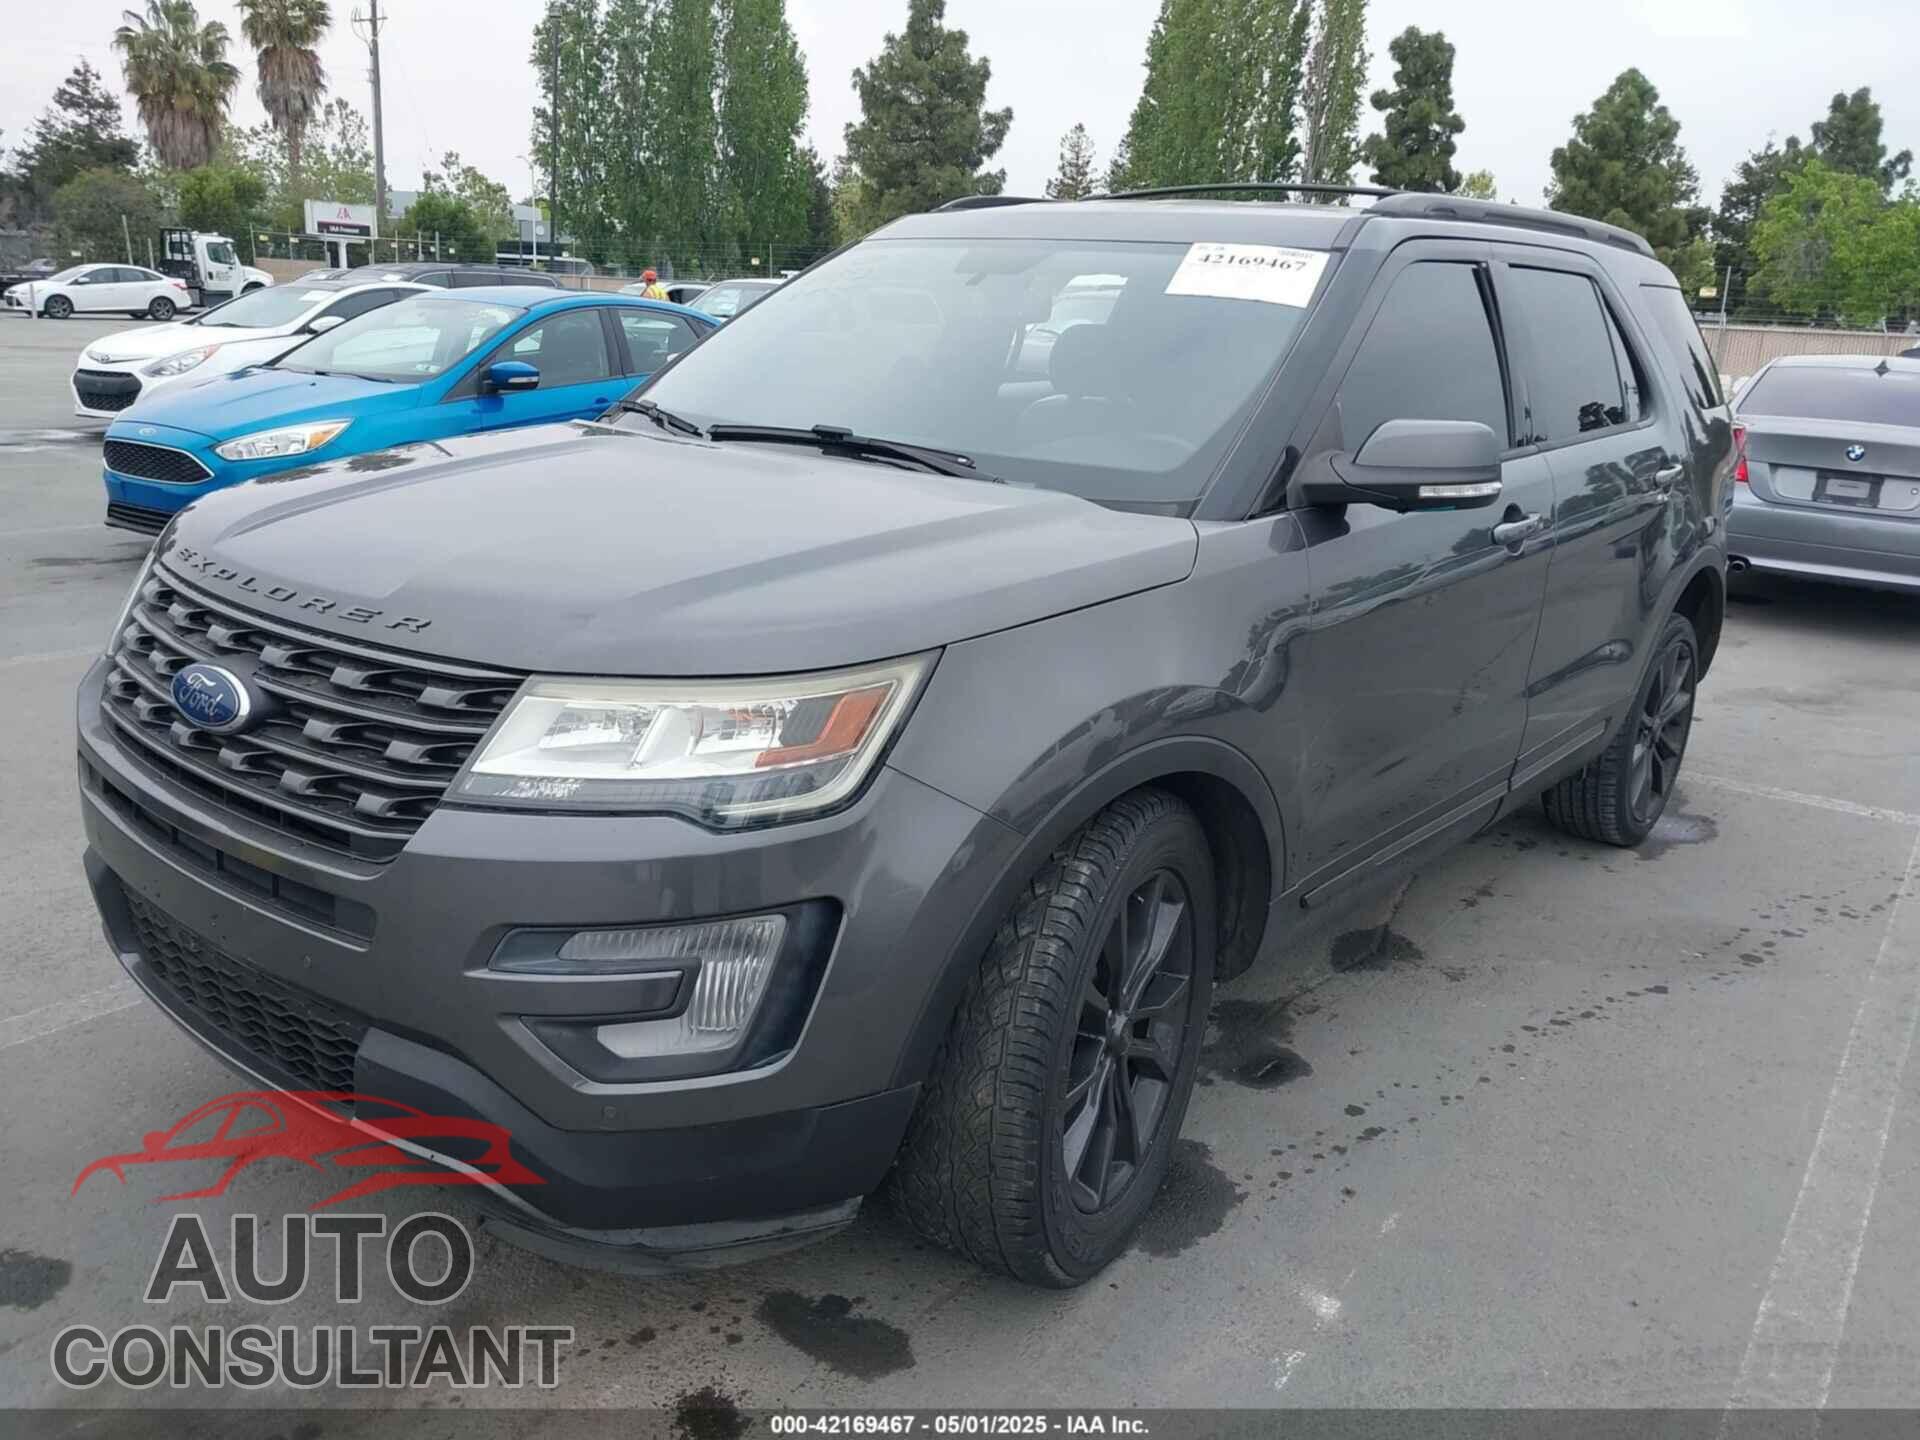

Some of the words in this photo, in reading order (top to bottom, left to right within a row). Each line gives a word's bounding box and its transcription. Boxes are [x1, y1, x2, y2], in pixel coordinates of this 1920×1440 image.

[1198, 253, 1307, 273] 42169467
[178, 548, 433, 634] EXPLORER
[179, 672, 224, 716] Ford
